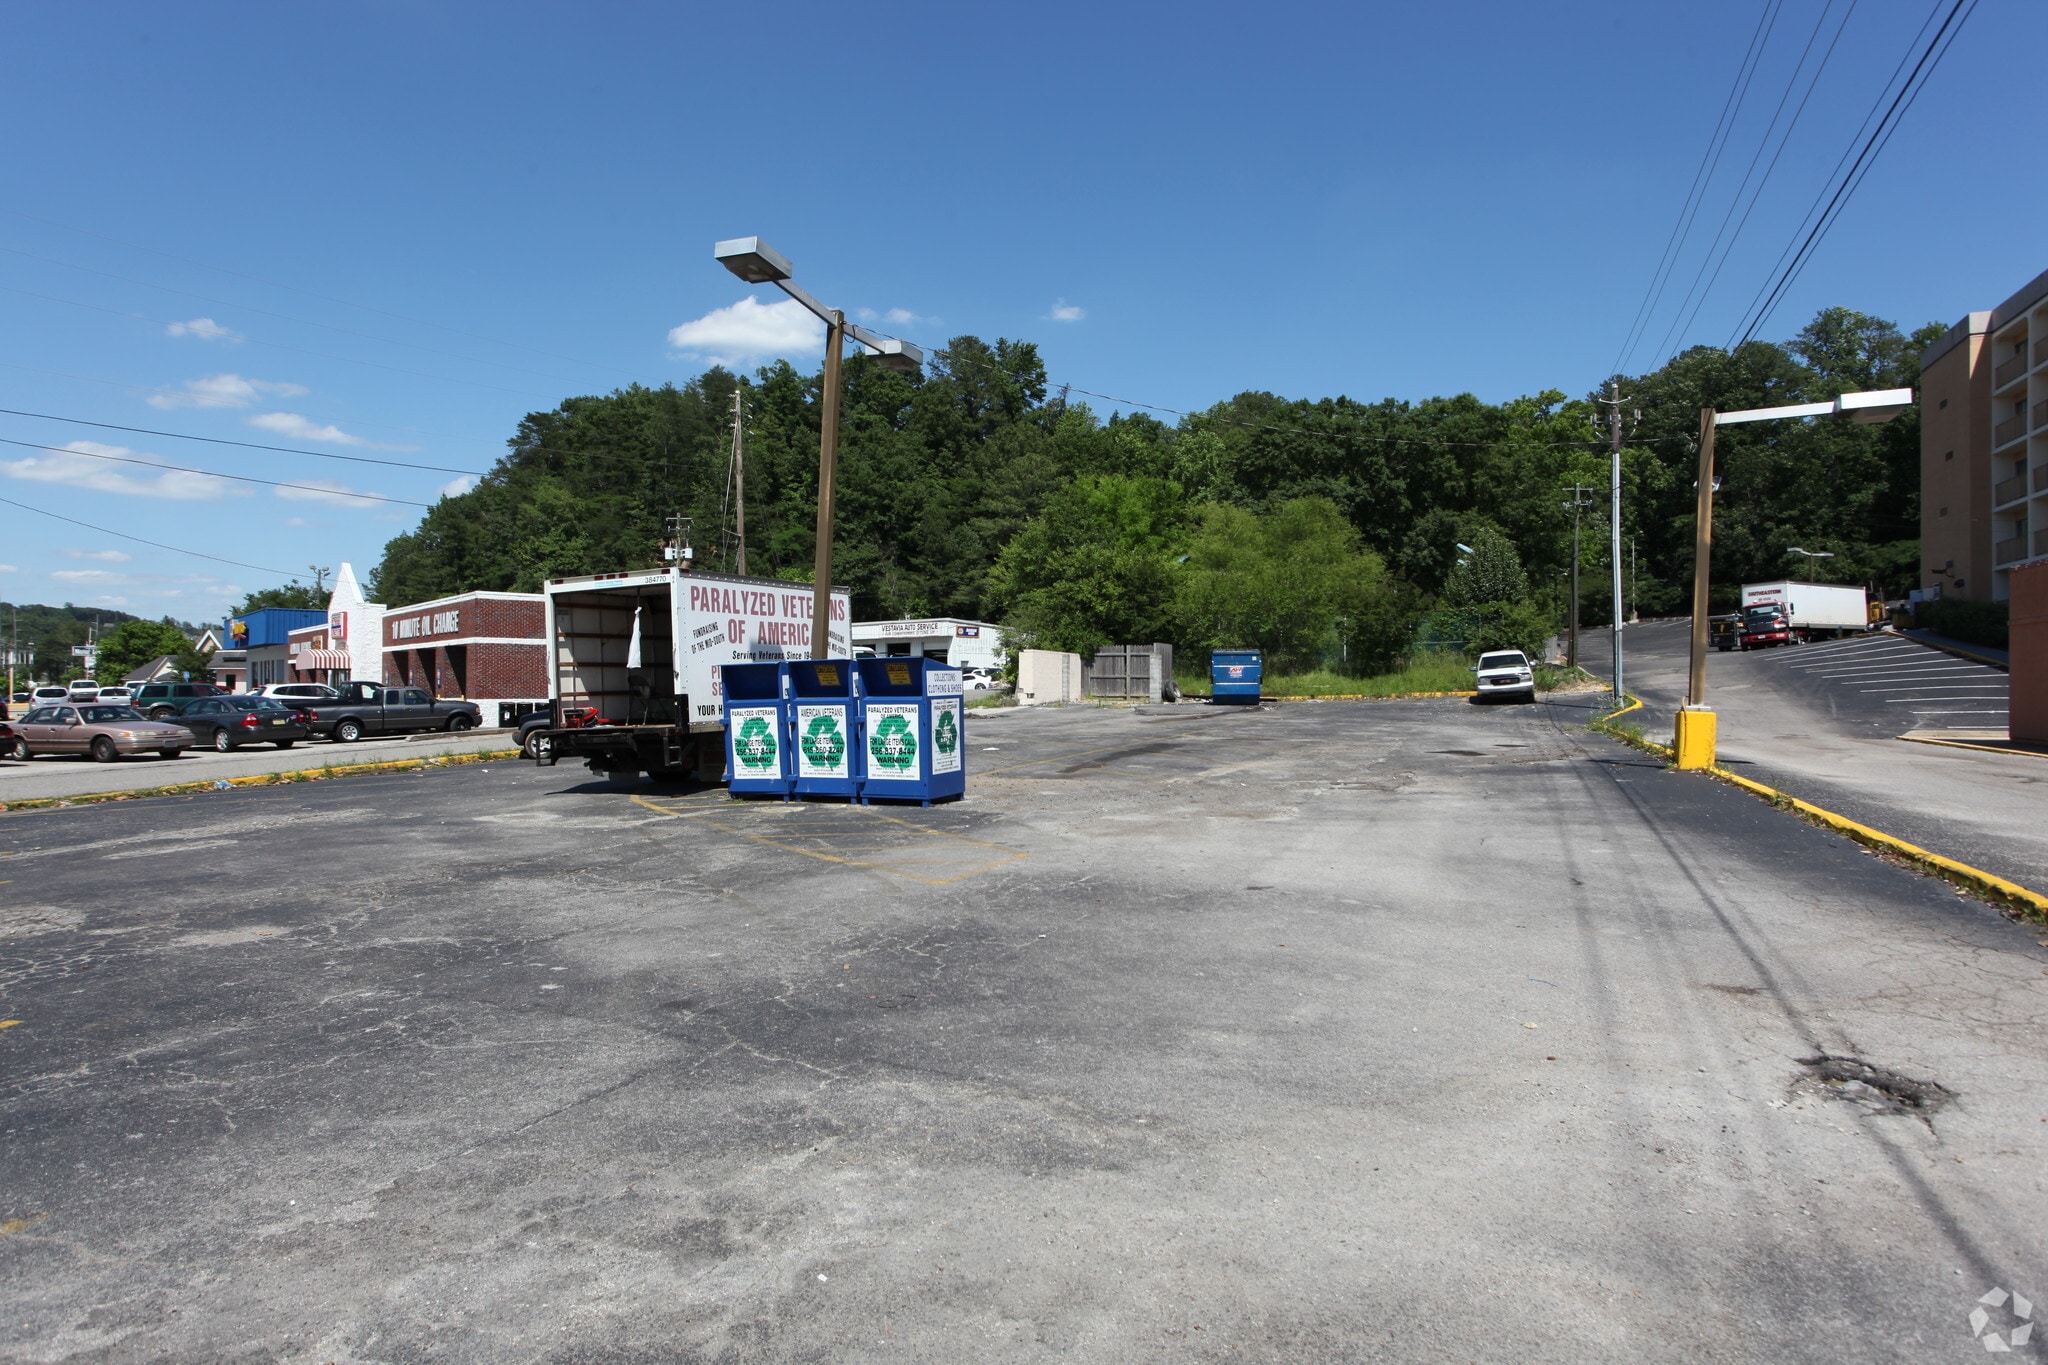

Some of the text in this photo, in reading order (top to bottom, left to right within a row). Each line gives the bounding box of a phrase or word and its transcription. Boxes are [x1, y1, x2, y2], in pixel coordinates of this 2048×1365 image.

[645, 575, 667, 584] 384770
[691, 585, 845, 621] PARALYZED VETENS
[400, 617, 420, 639] MINUTE
[422, 615, 431, 636] OIL
[693, 621, 718, 639] FUNDRAISING
[728, 618, 812, 647] OF AMERIC
[691, 633, 725, 654] OF THE MID-SOUTH
[732, 650, 756, 662] Serving
[759, 651, 784, 660] Veterans
[787, 651, 802, 660] Since
[934, 673, 956, 682] COLLECTIONS
[929, 685, 947, 694] CLOTHING
[951, 684, 962, 693] SHOES
[698, 705, 715, 716] YOUR
[801, 708, 843, 717] AMERICAN VETERANS
[870, 738, 878, 746] FOR
[878, 738, 891, 746] LARGE
[892, 738, 904, 746] ITEMS
[871, 747, 916, 755] 256-837-8444
